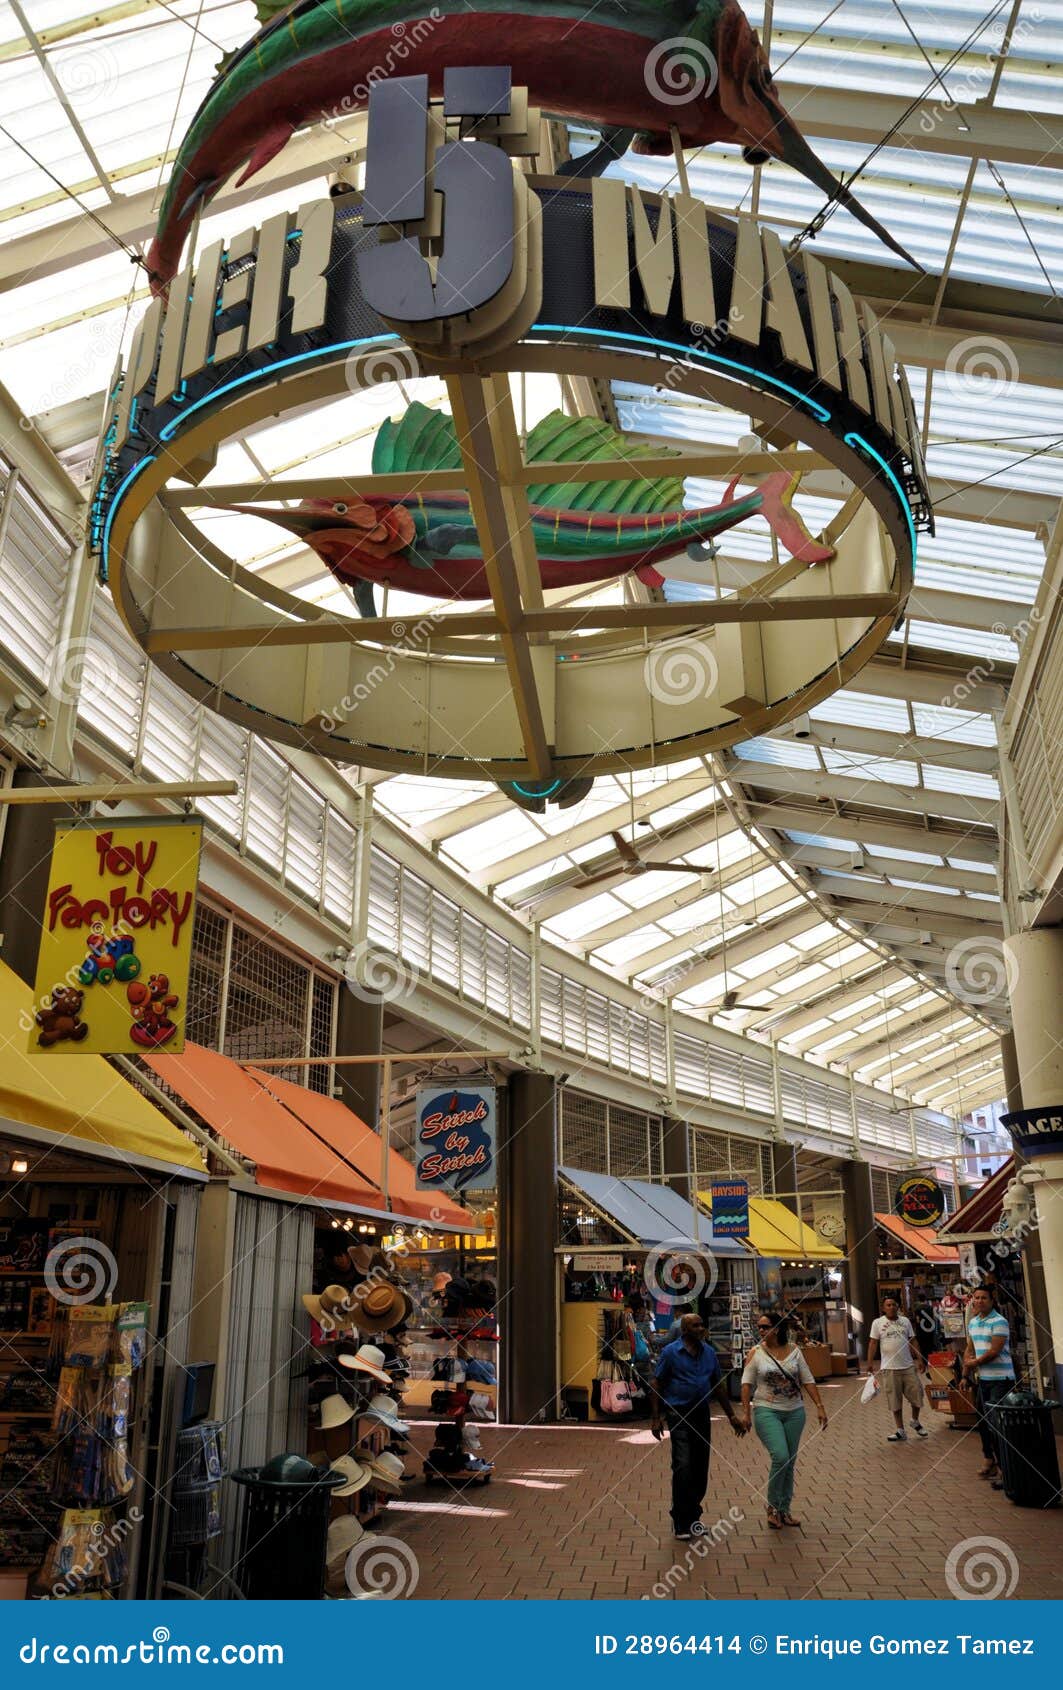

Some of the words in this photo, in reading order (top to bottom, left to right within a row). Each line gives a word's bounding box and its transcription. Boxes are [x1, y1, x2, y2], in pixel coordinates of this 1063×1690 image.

[358, 66, 515, 324] 5
[421, 1100, 488, 1139] Stitch
[445, 1131, 470, 1155] by
[420, 1145, 487, 1181] Stitch
[712, 1185, 748, 1197] BAYSIDE
